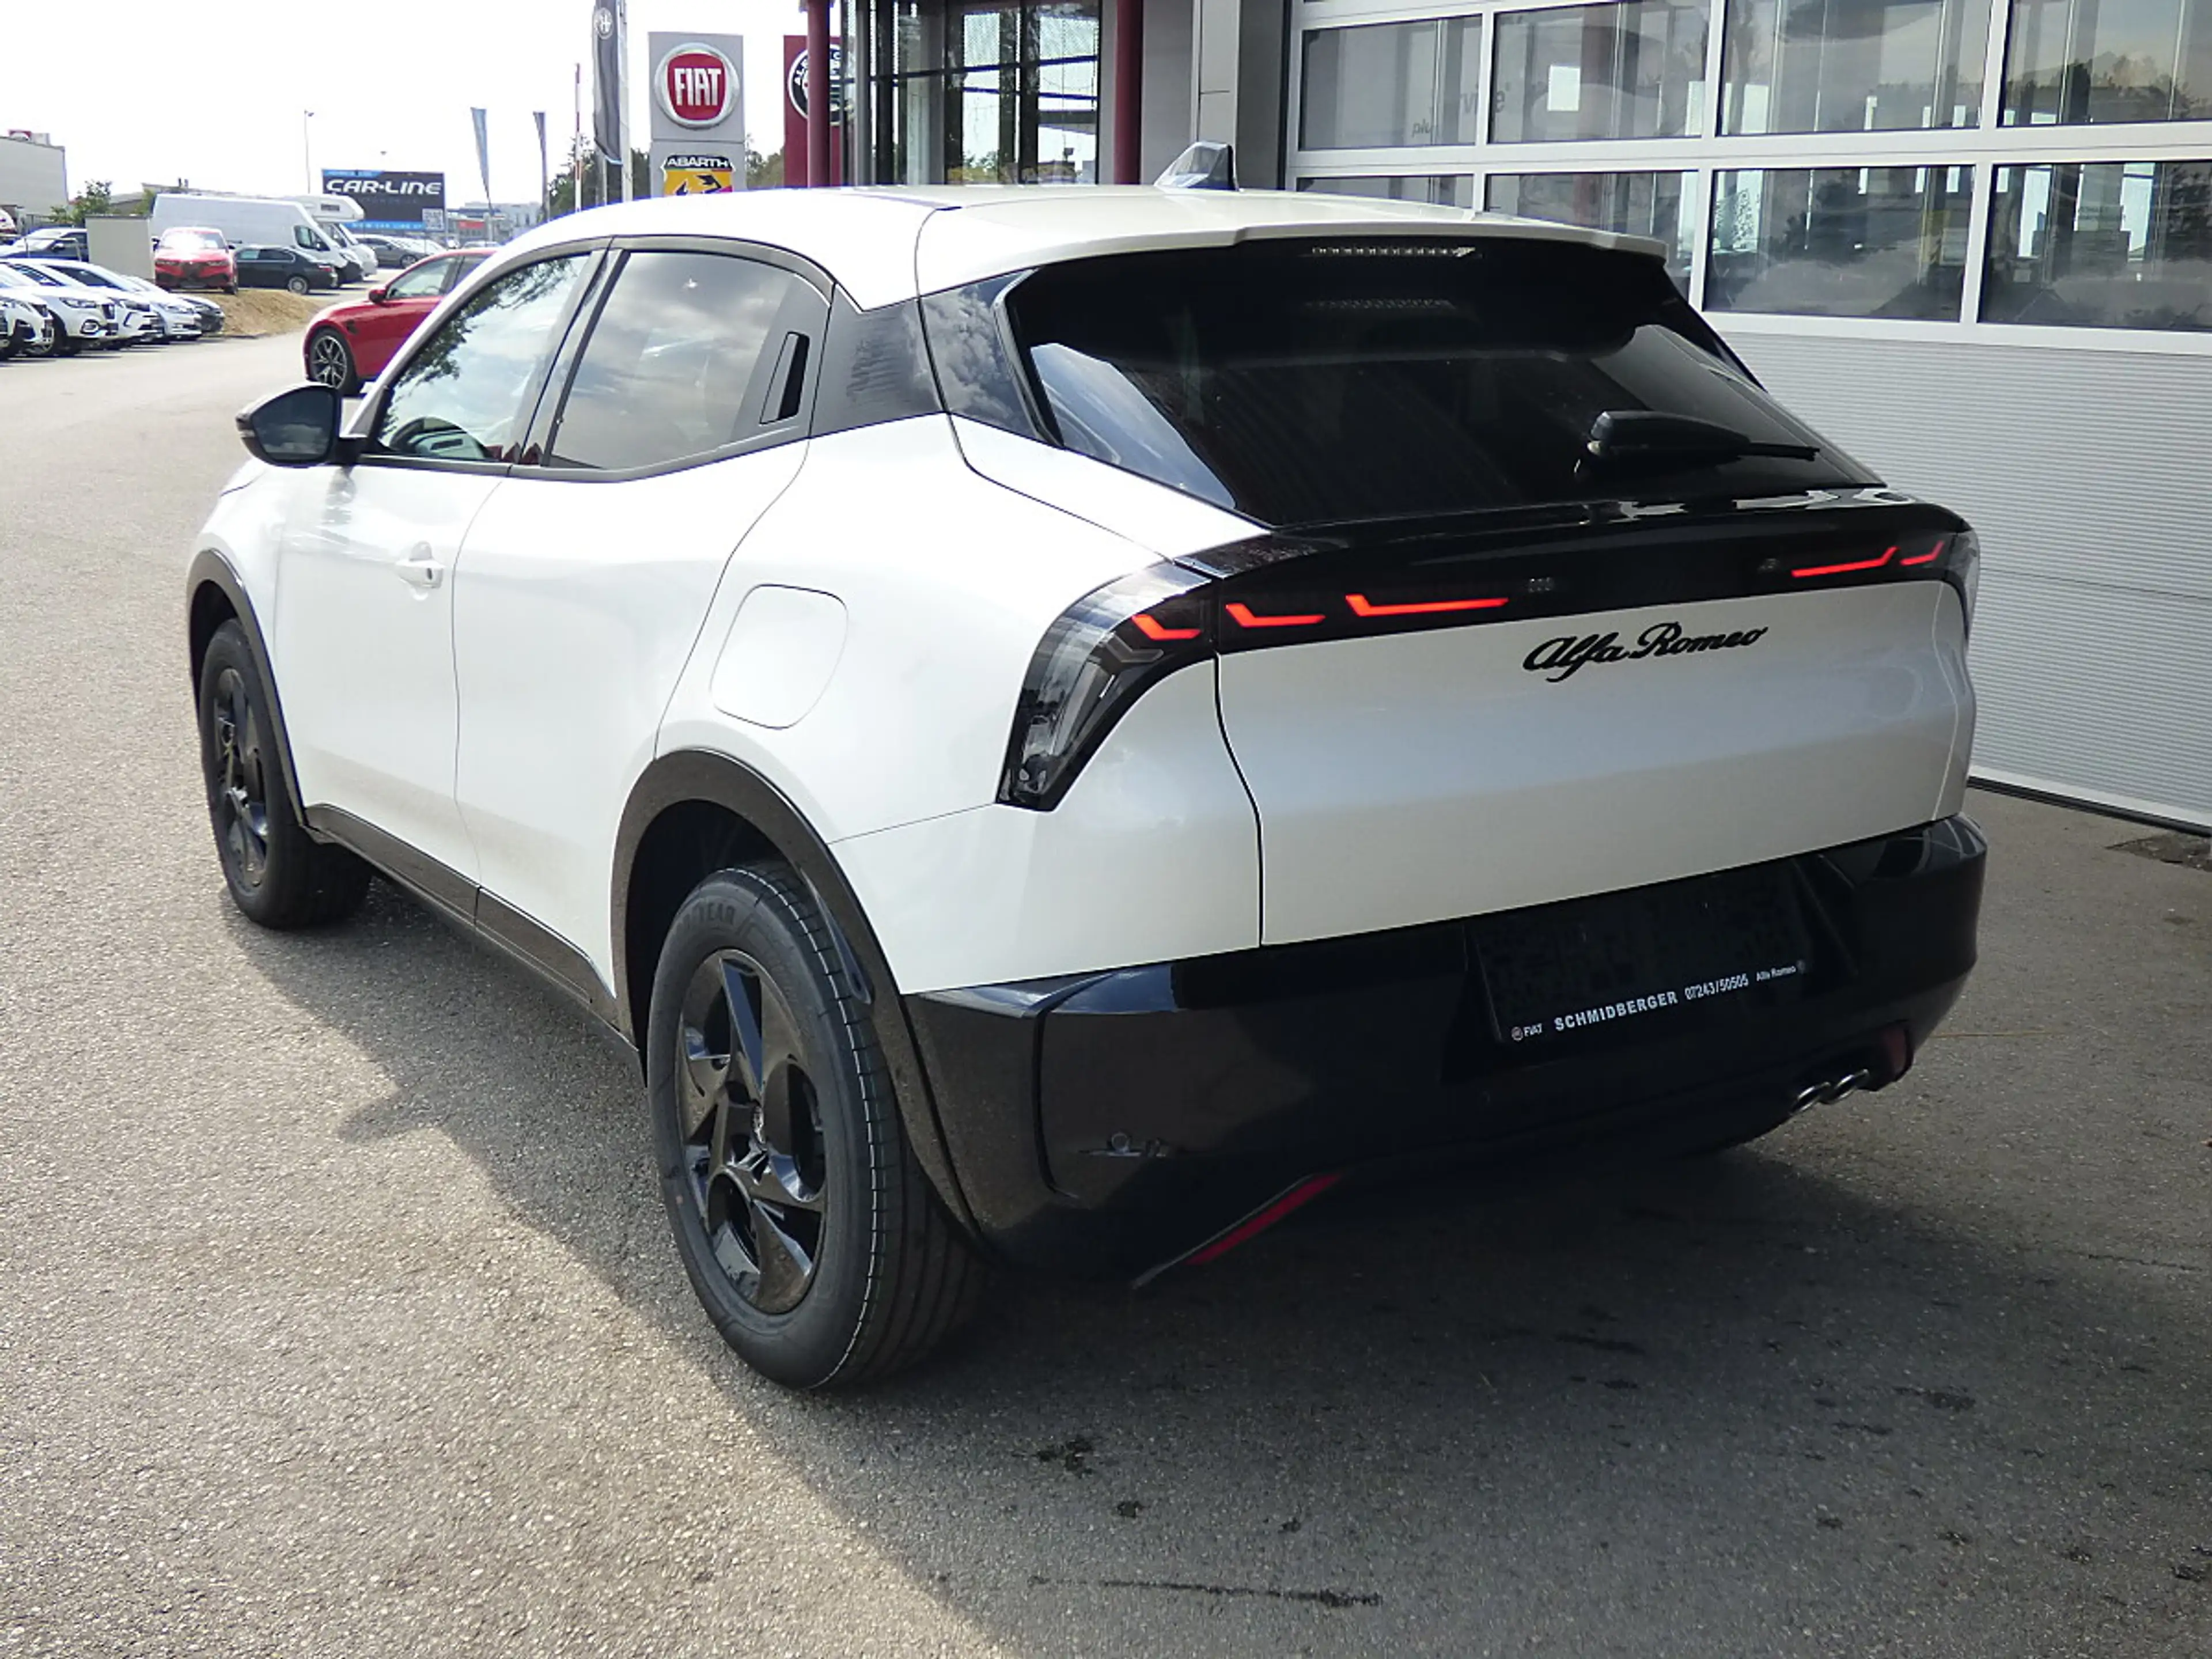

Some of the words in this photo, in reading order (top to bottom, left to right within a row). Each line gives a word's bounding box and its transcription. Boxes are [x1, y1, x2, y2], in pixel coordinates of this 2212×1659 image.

[674, 68, 721, 106] FIAT
[668, 157, 728, 168] ABARTH
[1522, 632, 1630, 683] Alfa
[1628, 621, 1768, 660] Romeo
[1523, 1023, 1543, 1037] FIAT
[1554, 991, 1679, 1031] SCHMIDBERGER
